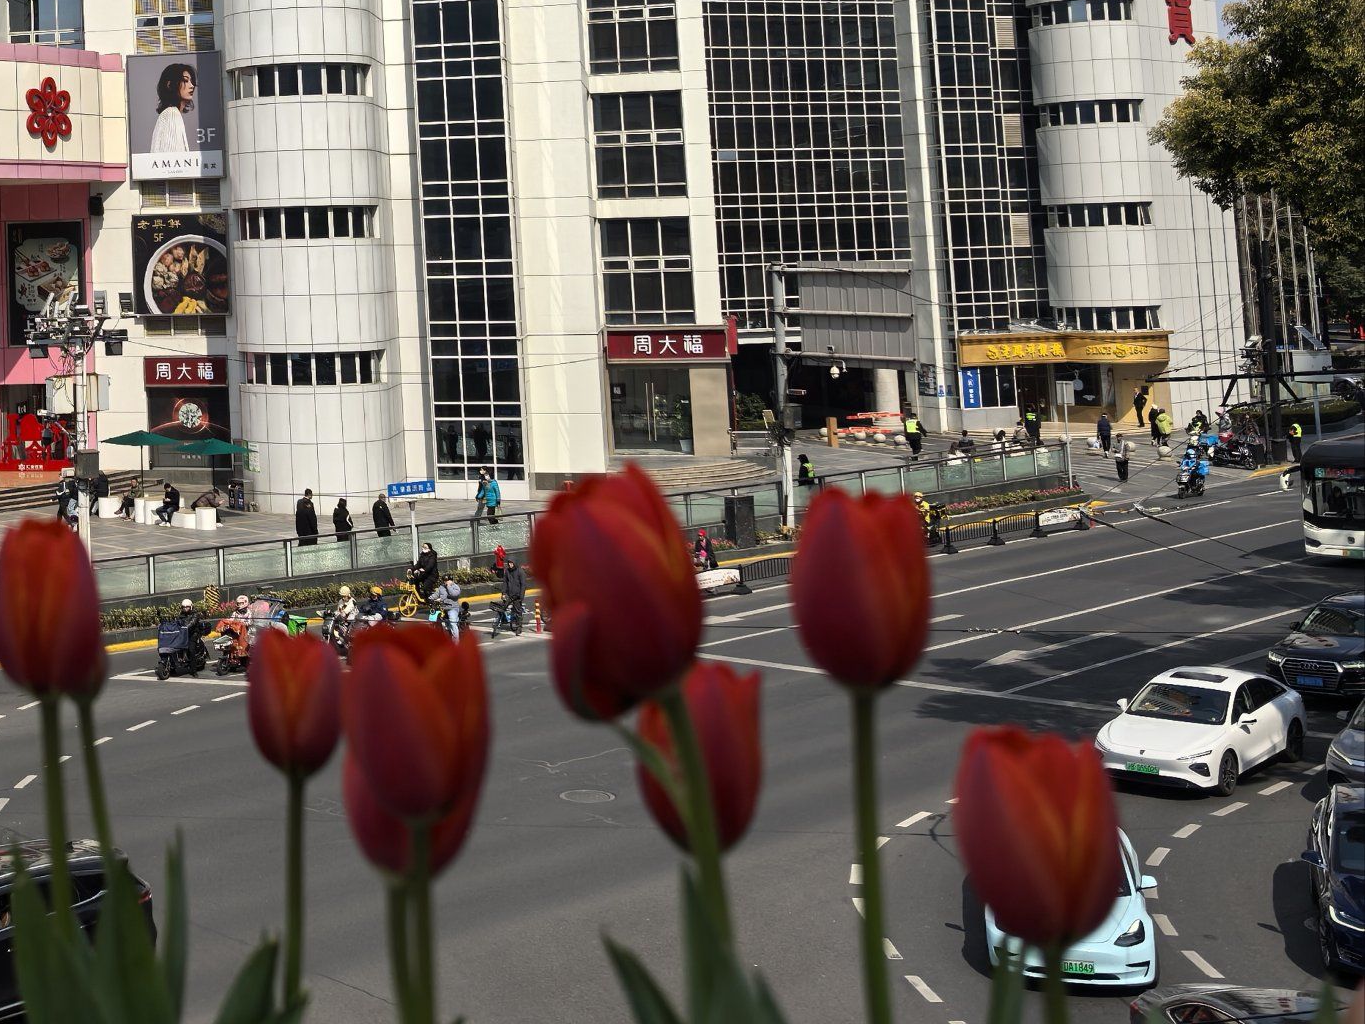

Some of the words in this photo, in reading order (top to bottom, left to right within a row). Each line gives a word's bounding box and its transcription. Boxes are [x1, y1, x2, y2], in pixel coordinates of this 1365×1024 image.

[196, 128, 216, 144] 3F
[151, 158, 200, 169] AMANI
[153, 233, 164, 243] 5F
[633, 335, 704, 355] 周大福
[1085, 345, 1112, 355] SINCE
[156, 362, 214, 380] 周大福
